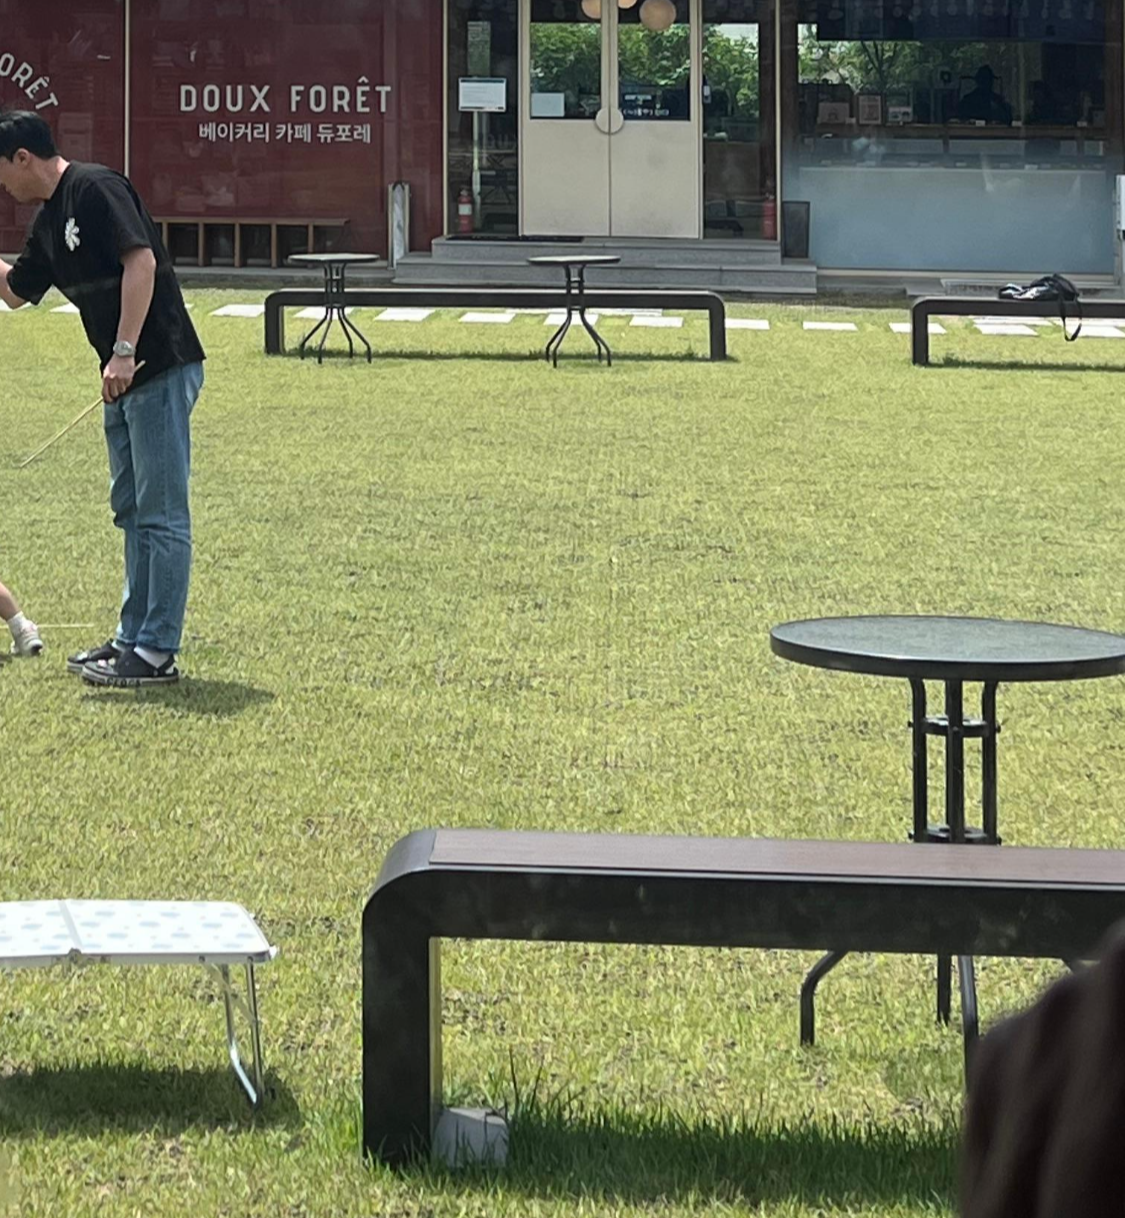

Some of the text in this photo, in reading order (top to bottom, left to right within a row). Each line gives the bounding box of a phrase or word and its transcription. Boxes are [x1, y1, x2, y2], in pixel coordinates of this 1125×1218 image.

[180, 76, 392, 113] DOUX FORÊT
[198, 122, 372, 144] 베이커리 카페 듀포레
